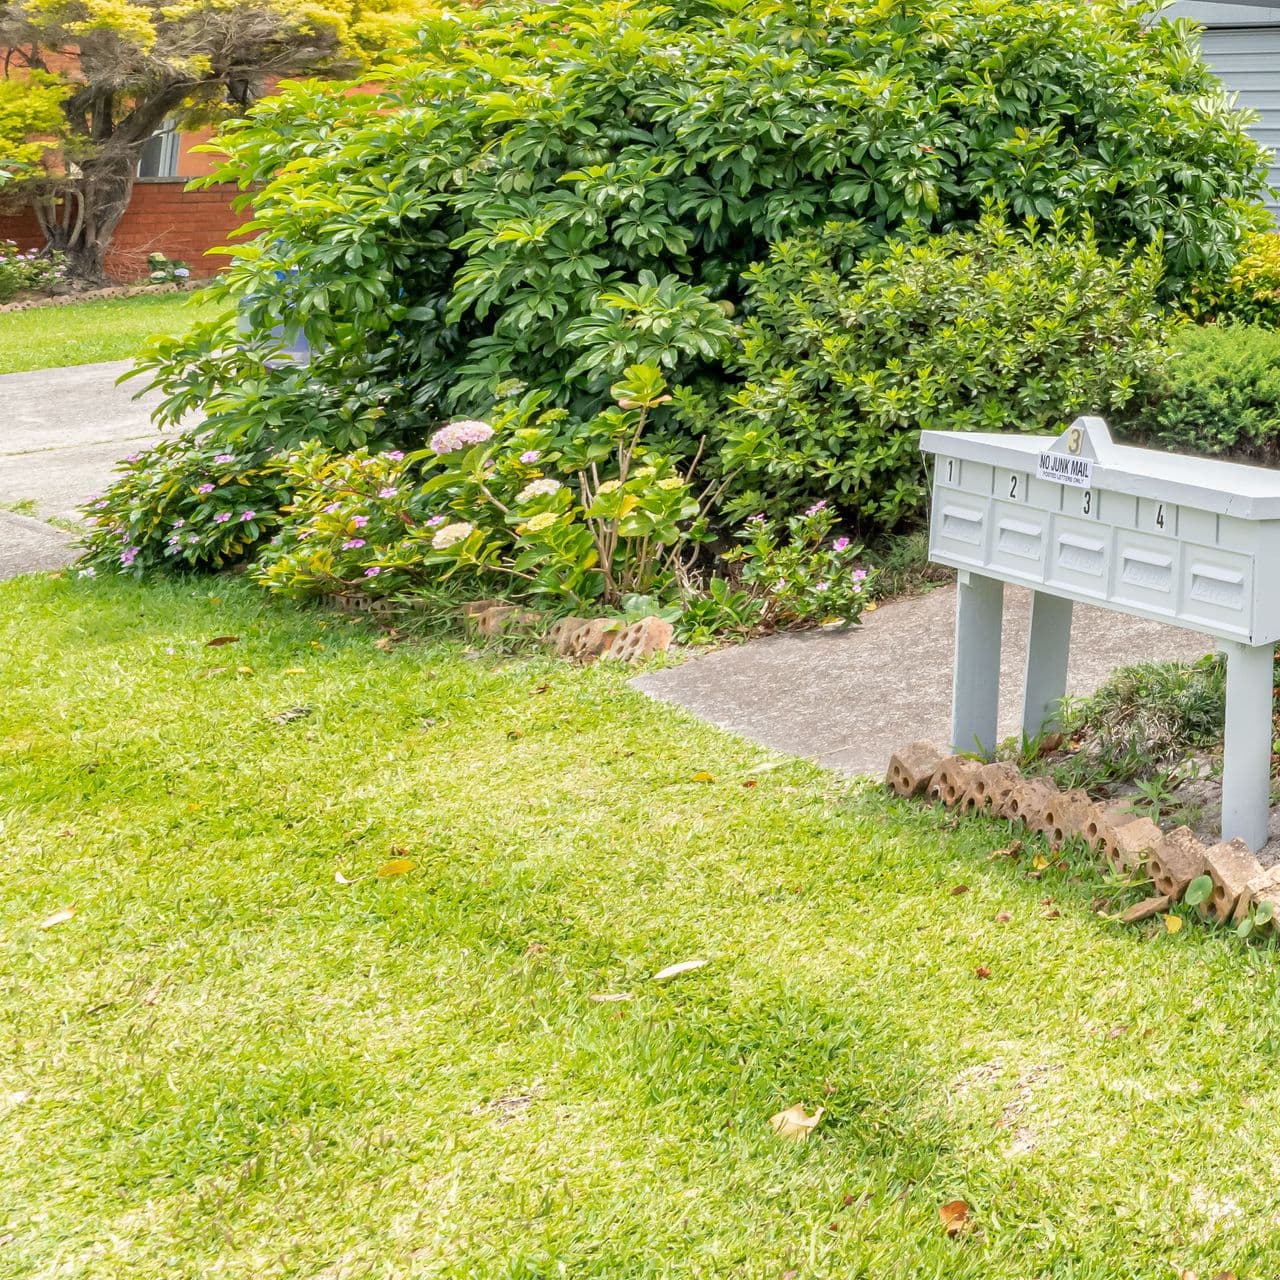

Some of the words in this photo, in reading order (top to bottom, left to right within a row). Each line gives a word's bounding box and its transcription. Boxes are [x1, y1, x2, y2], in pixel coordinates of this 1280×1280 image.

[1068, 428, 1081, 454] 3
[948, 460, 953, 482] 1
[1039, 454, 1051, 470] NO
[1051, 456, 1071, 475] JUNK
[1070, 460, 1089, 478] MAIL
[1009, 475, 1018, 499] 2
[1083, 490, 1091, 515] 3
[1156, 504, 1164, 529] 4
